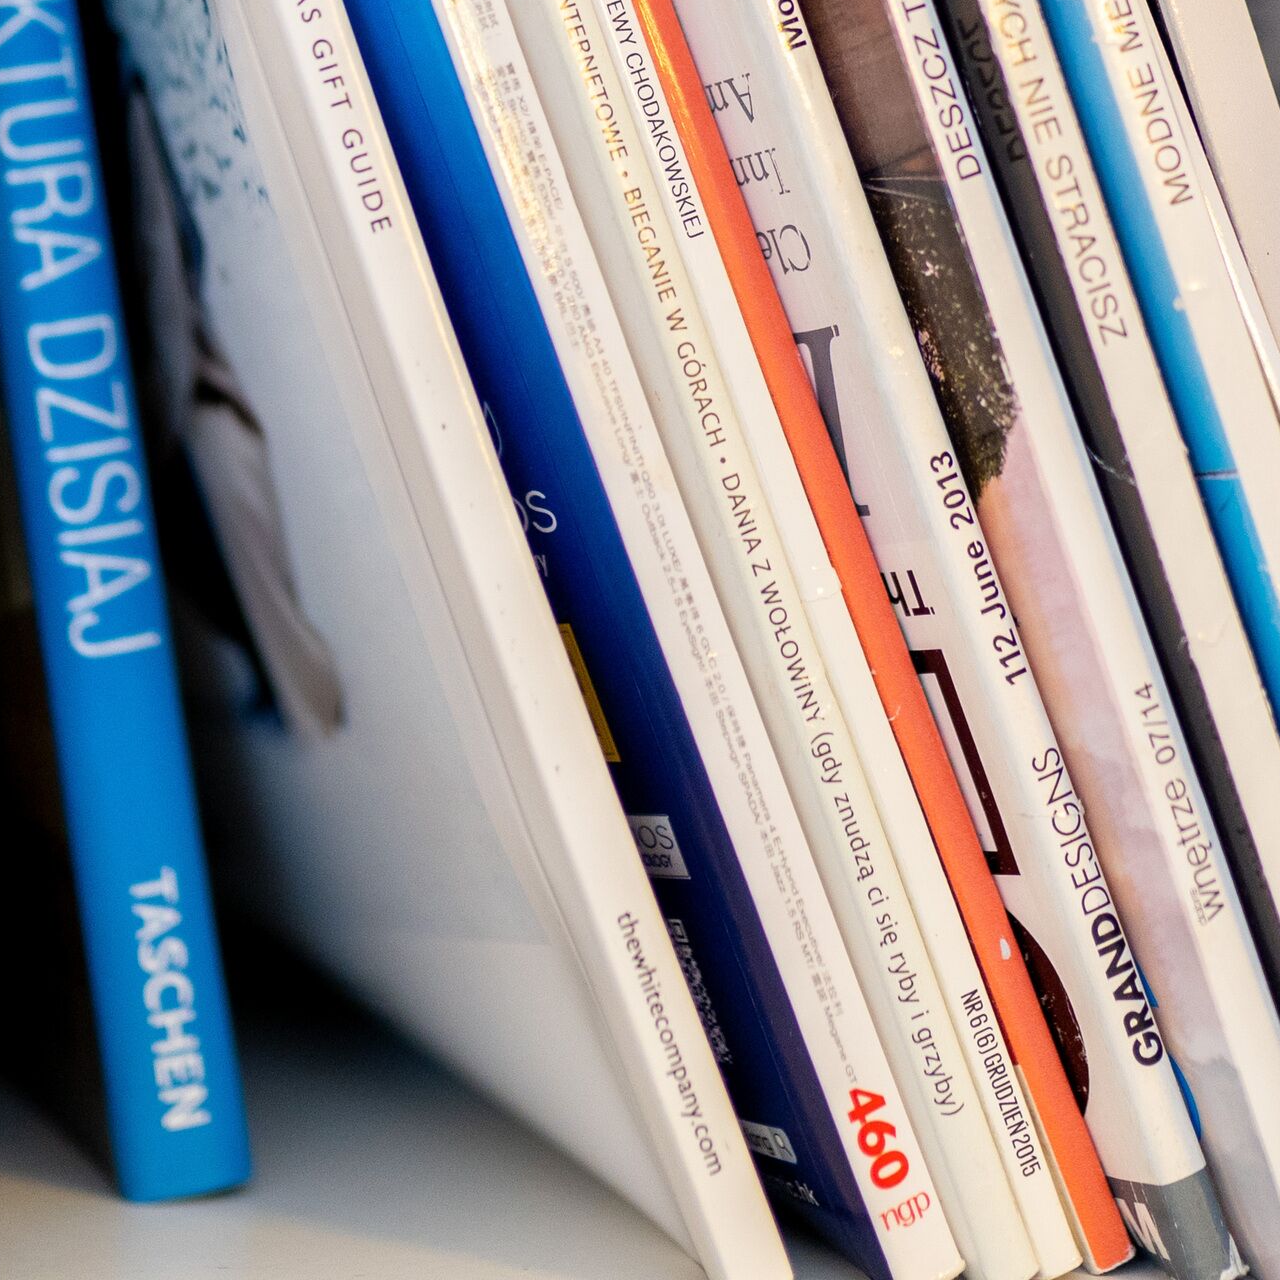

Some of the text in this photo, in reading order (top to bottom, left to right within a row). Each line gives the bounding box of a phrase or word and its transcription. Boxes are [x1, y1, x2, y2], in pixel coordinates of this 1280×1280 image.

[312, 38, 352, 109] GIFT
[342, 128, 392, 233] GUIDE
[606, 0, 637, 44] EWY
[625, 52, 705, 239] CHODAKOWSKIEJ
[913, 32, 982, 180] DESZCZ
[1136, 63, 1194, 206] MODNE
[623, 187, 677, 303] BIEGANIE
[1020, 76, 1063, 144] NIE
[1045, 154, 1129, 346] STRACISZ
[666, 307, 688, 332] W
[677, 341, 727, 448] GÓRACH
[28, 313, 160, 659] DZISIAJ
[721, 472, 762, 555] DANIA
[751, 558, 772, 577] Z
[930, 440, 1025, 686] 112 June 2013
[810, 731, 843, 784] (gdy
[833, 792, 875, 882] znudzą
[867, 886, 890, 906] ci
[876, 912, 898, 947] się
[131, 866, 211, 1132] TASCHEN
[890, 952, 920, 1003] ryby
[911, 1009, 930, 1021] i
[617, 911, 722, 1176] thewhitecompany.com
[915, 1027, 965, 1116] grzyby)
[960, 988, 1041, 1177] NR 6 (6) GRUDZIEŃ 2015
[847, 1086, 910, 1189] 460
[880, 1190, 932, 1231] ngp
